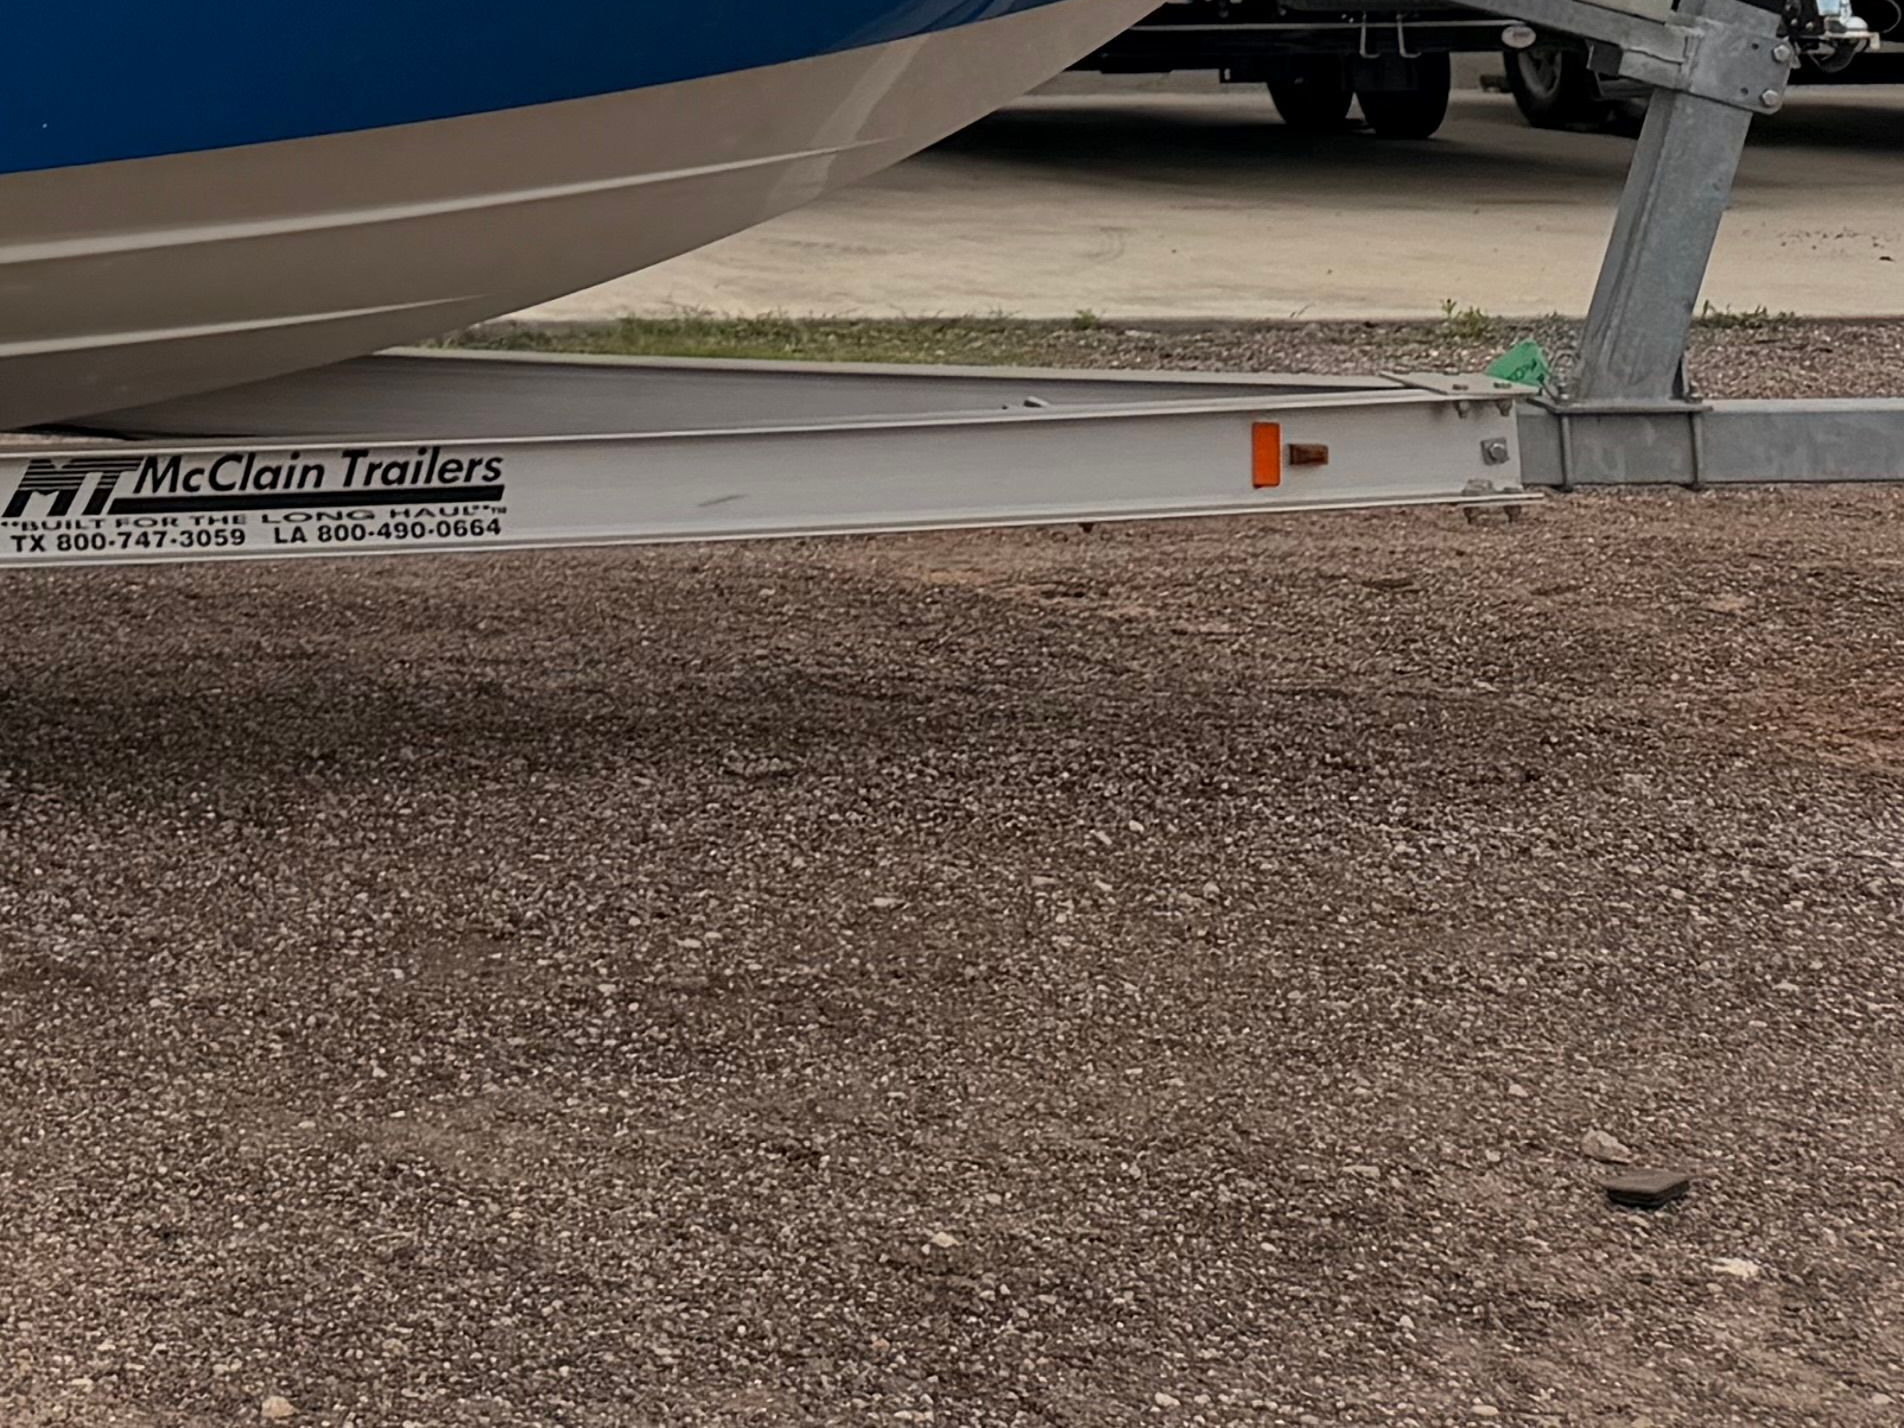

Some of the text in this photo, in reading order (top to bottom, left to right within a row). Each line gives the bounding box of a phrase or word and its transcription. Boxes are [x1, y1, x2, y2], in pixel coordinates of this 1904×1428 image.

[133, 451, 325, 494] McClain
[342, 446, 503, 488] Trailers
[10, 518, 501, 553] TX 800-747-3059 LA 800-490-0664
[115, 517, 179, 529] FOR
[192, 515, 247, 526] THE
[262, 509, 375, 523] LONG
